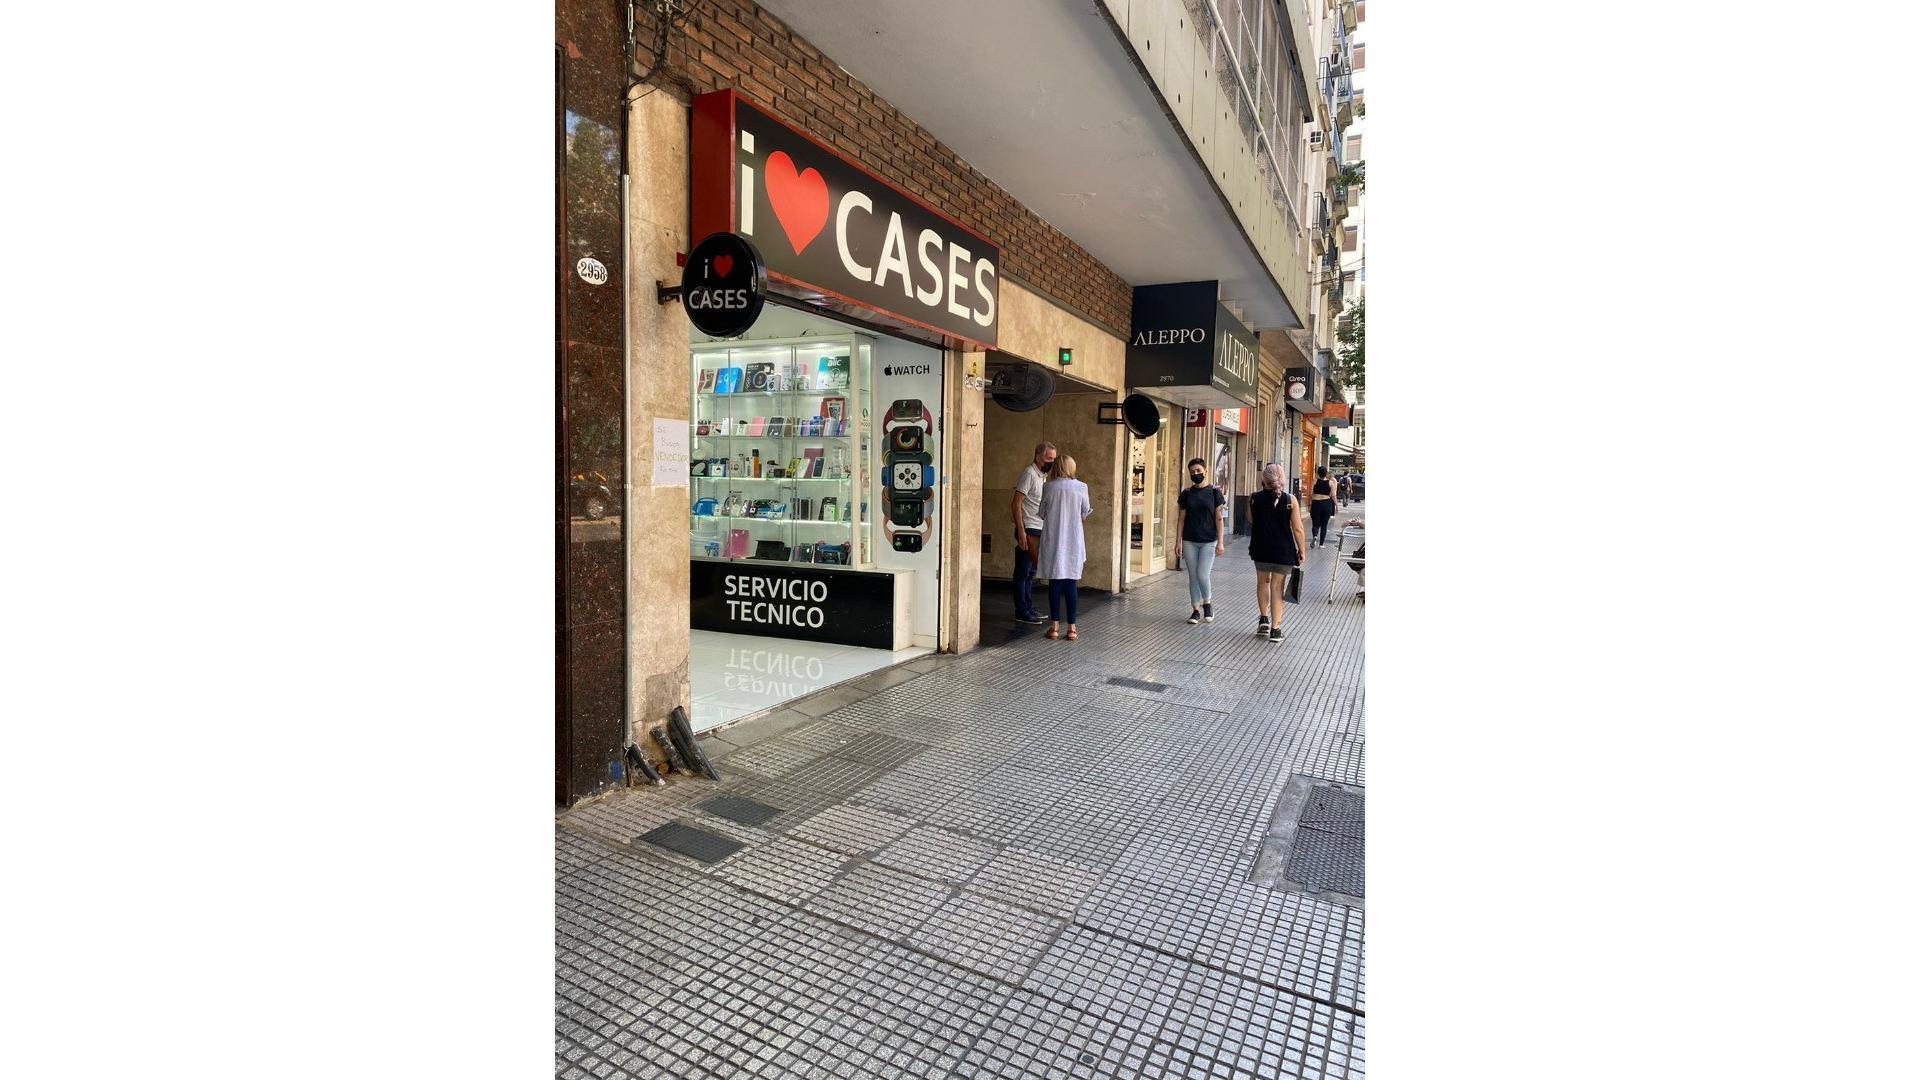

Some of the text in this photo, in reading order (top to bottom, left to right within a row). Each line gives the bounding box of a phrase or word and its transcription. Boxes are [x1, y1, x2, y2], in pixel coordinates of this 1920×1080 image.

[740, 129, 996, 328] i CASES
[580, 261, 606, 282] 2958
[704, 258, 709, 279] i
[689, 288, 748, 310] CASES
[1133, 327, 1206, 347] ALEPPO
[1218, 329, 1256, 387] ALEPPO
[893, 364, 930, 376] WATCH
[724, 574, 828, 603] SERVICIO
[726, 599, 825, 629] TECNICO
